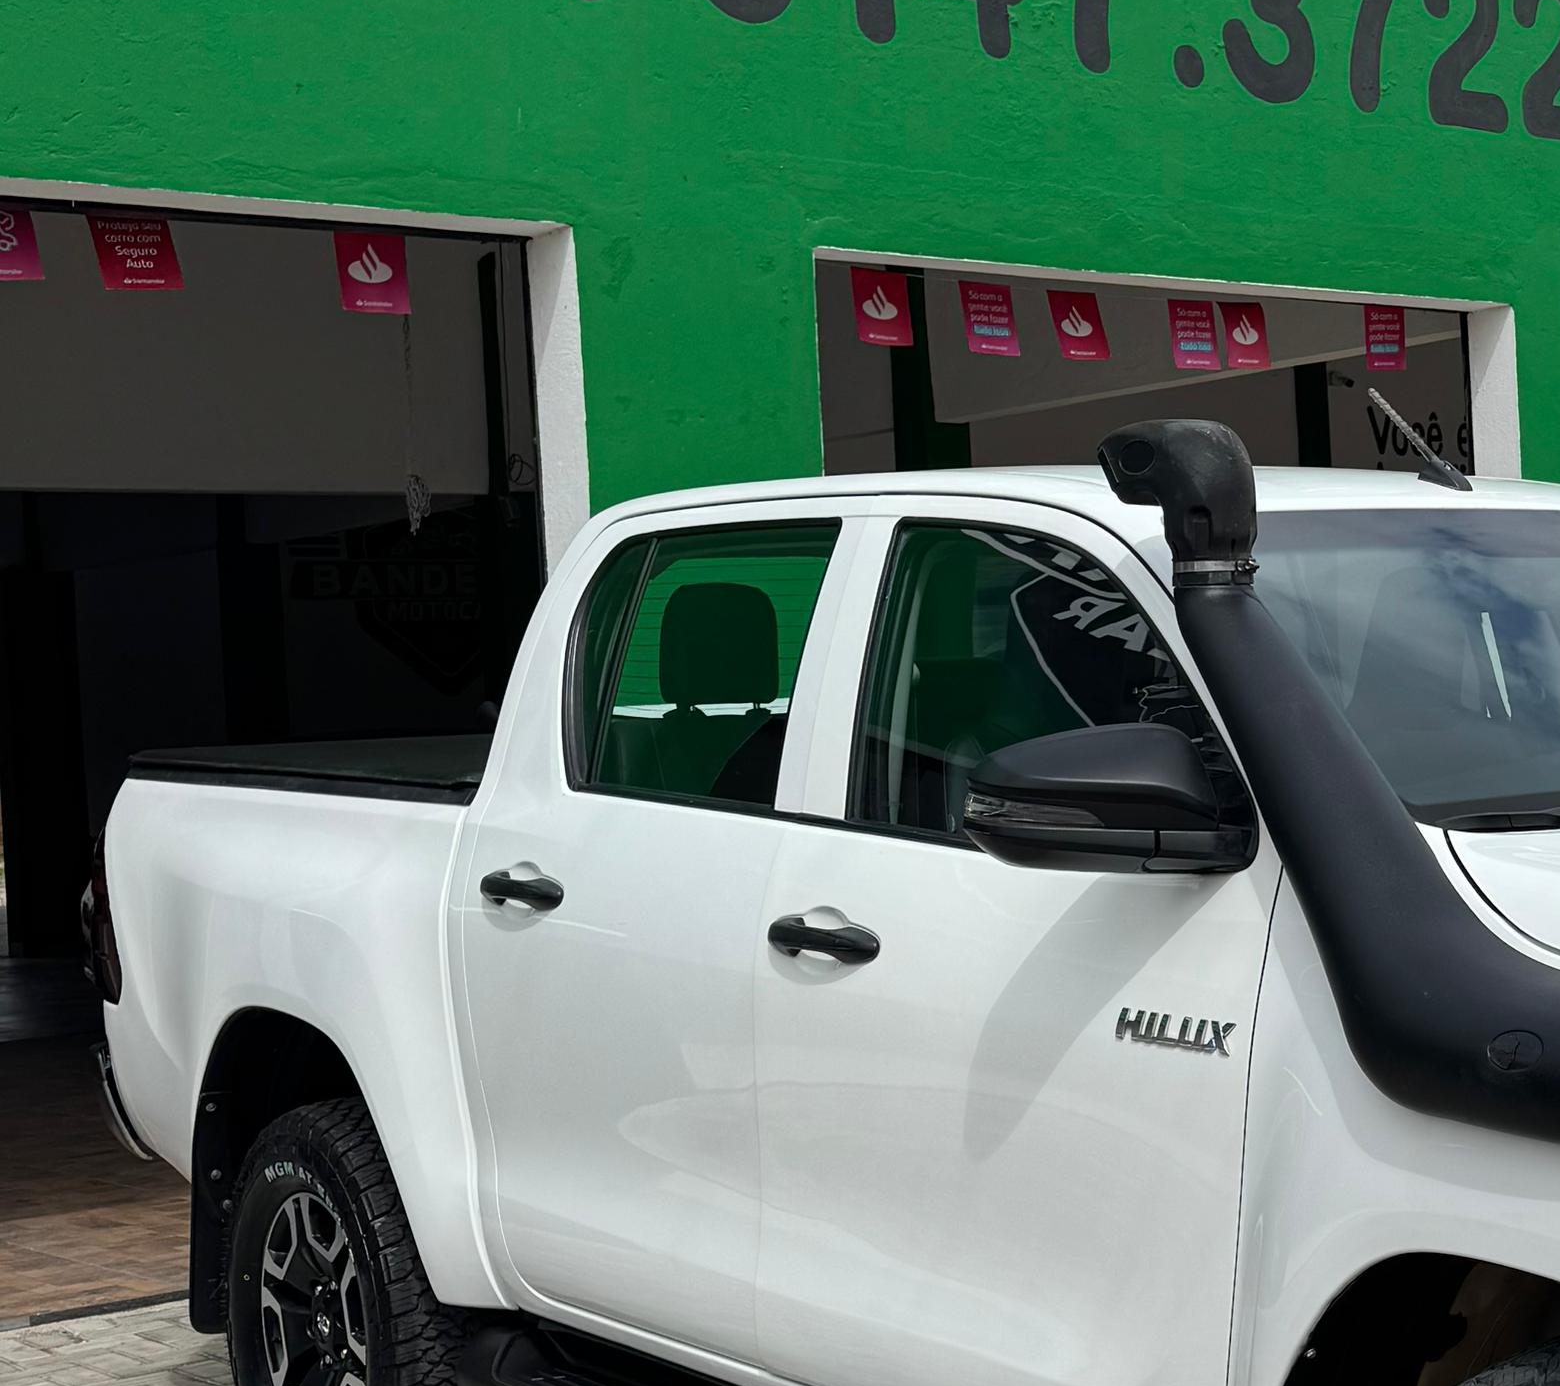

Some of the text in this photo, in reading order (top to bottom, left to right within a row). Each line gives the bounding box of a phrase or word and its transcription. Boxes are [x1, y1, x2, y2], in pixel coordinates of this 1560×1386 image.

[115, 245, 157, 258] Seguro
[126, 258, 154, 269] Auto
[1366, 405, 1443, 457] Você
[1115, 1007, 1237, 1057] HILUX
